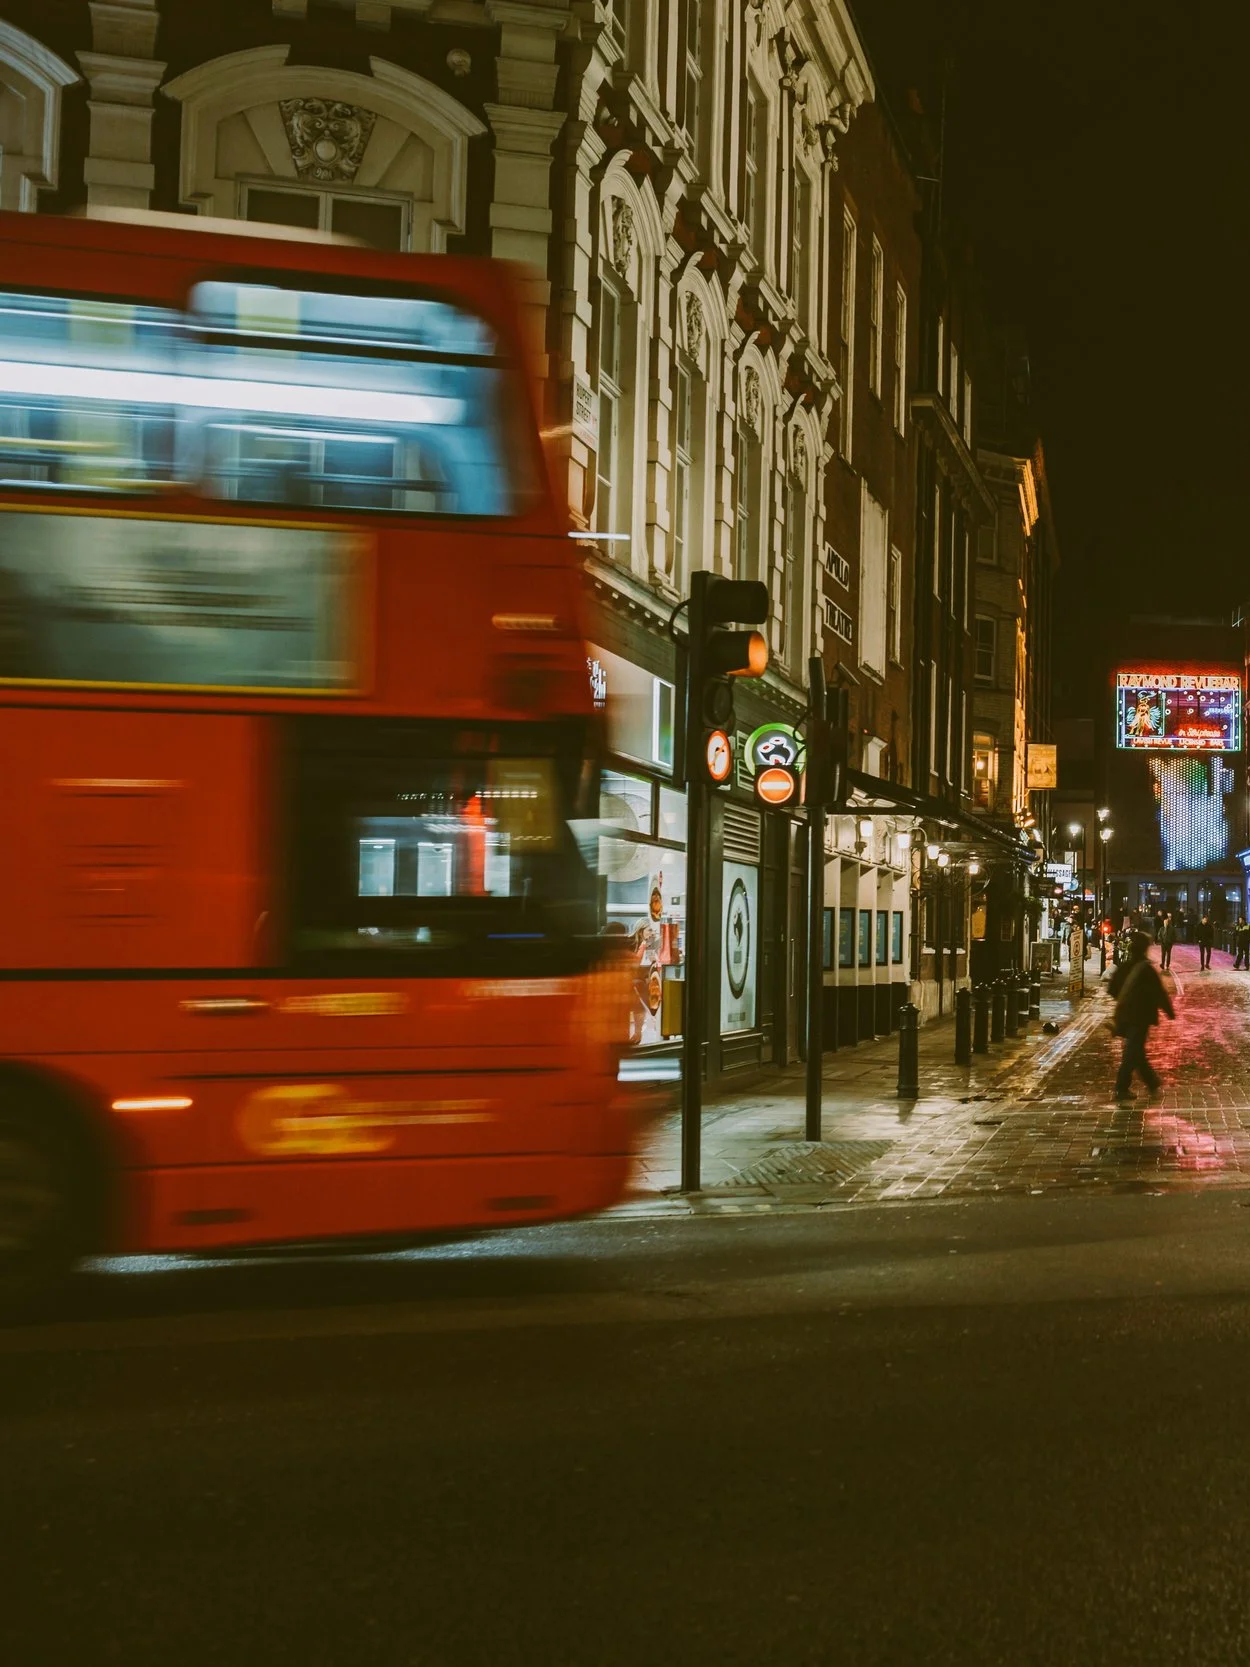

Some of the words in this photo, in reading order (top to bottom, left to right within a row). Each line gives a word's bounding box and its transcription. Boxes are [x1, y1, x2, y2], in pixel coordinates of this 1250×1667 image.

[825, 546, 849, 587] APOLLO
[1119, 675, 1177, 688] RAYMOND
[1181, 676, 1239, 689] REVUEBAR
